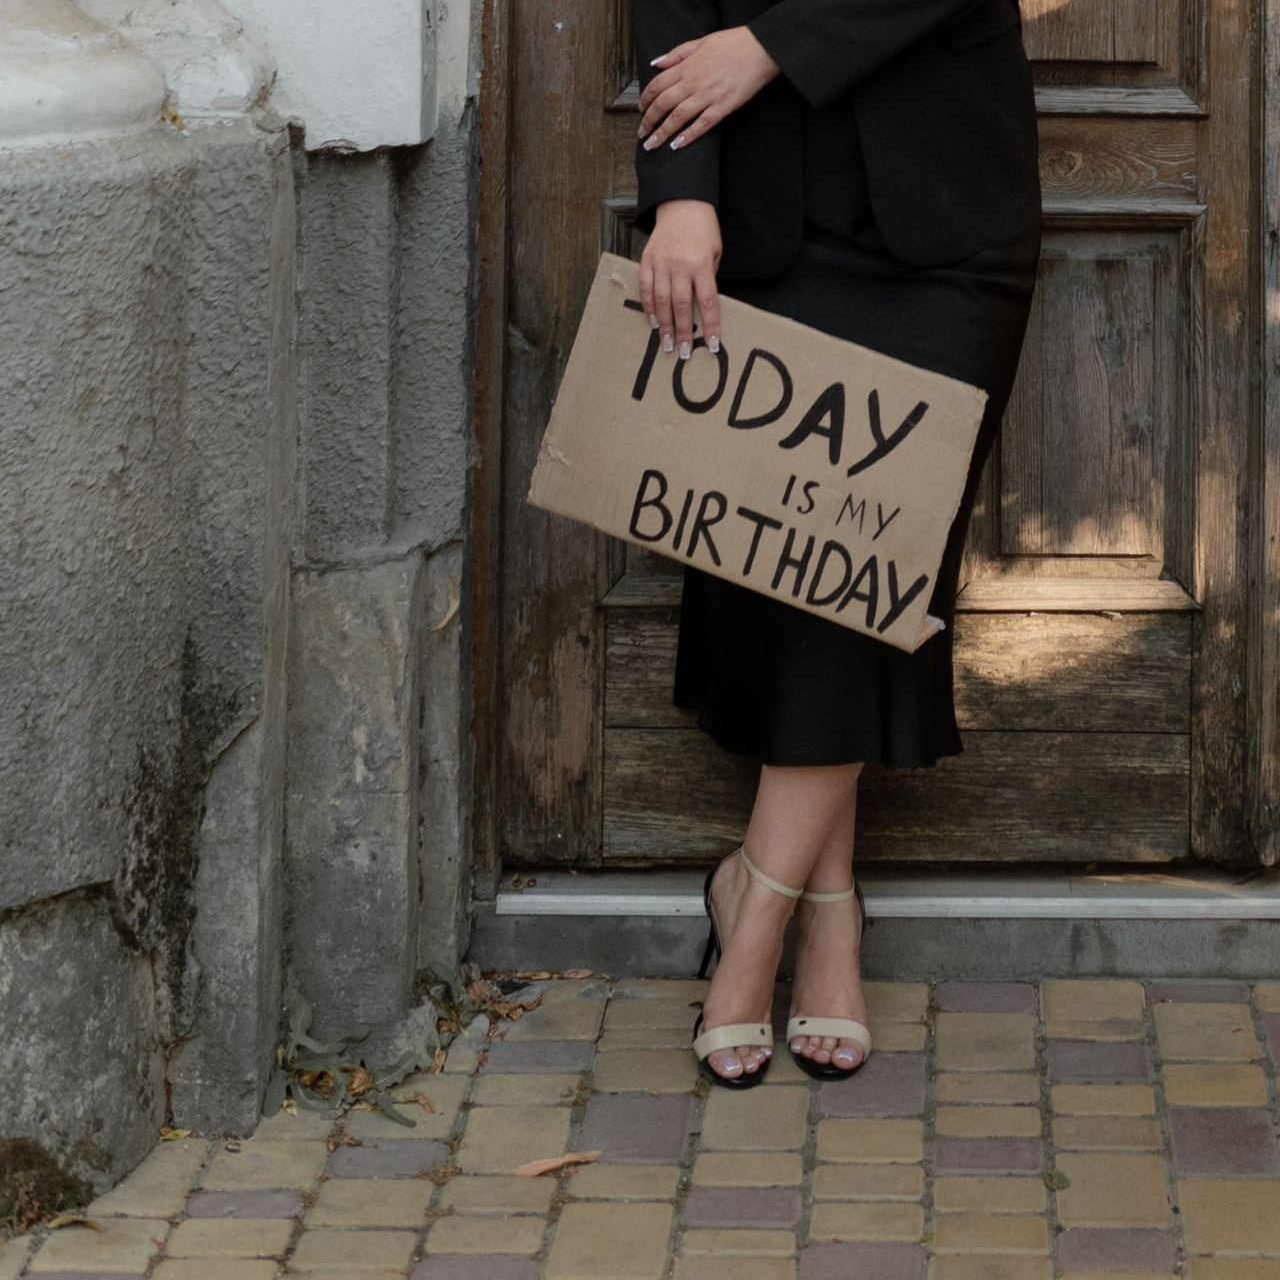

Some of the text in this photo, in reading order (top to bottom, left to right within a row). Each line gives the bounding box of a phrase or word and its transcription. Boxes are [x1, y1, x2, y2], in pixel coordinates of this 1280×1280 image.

[623, 299, 930, 478] TODAY
[629, 470, 930, 635] BIRTHDAY
[781, 475, 901, 541] IS MY
